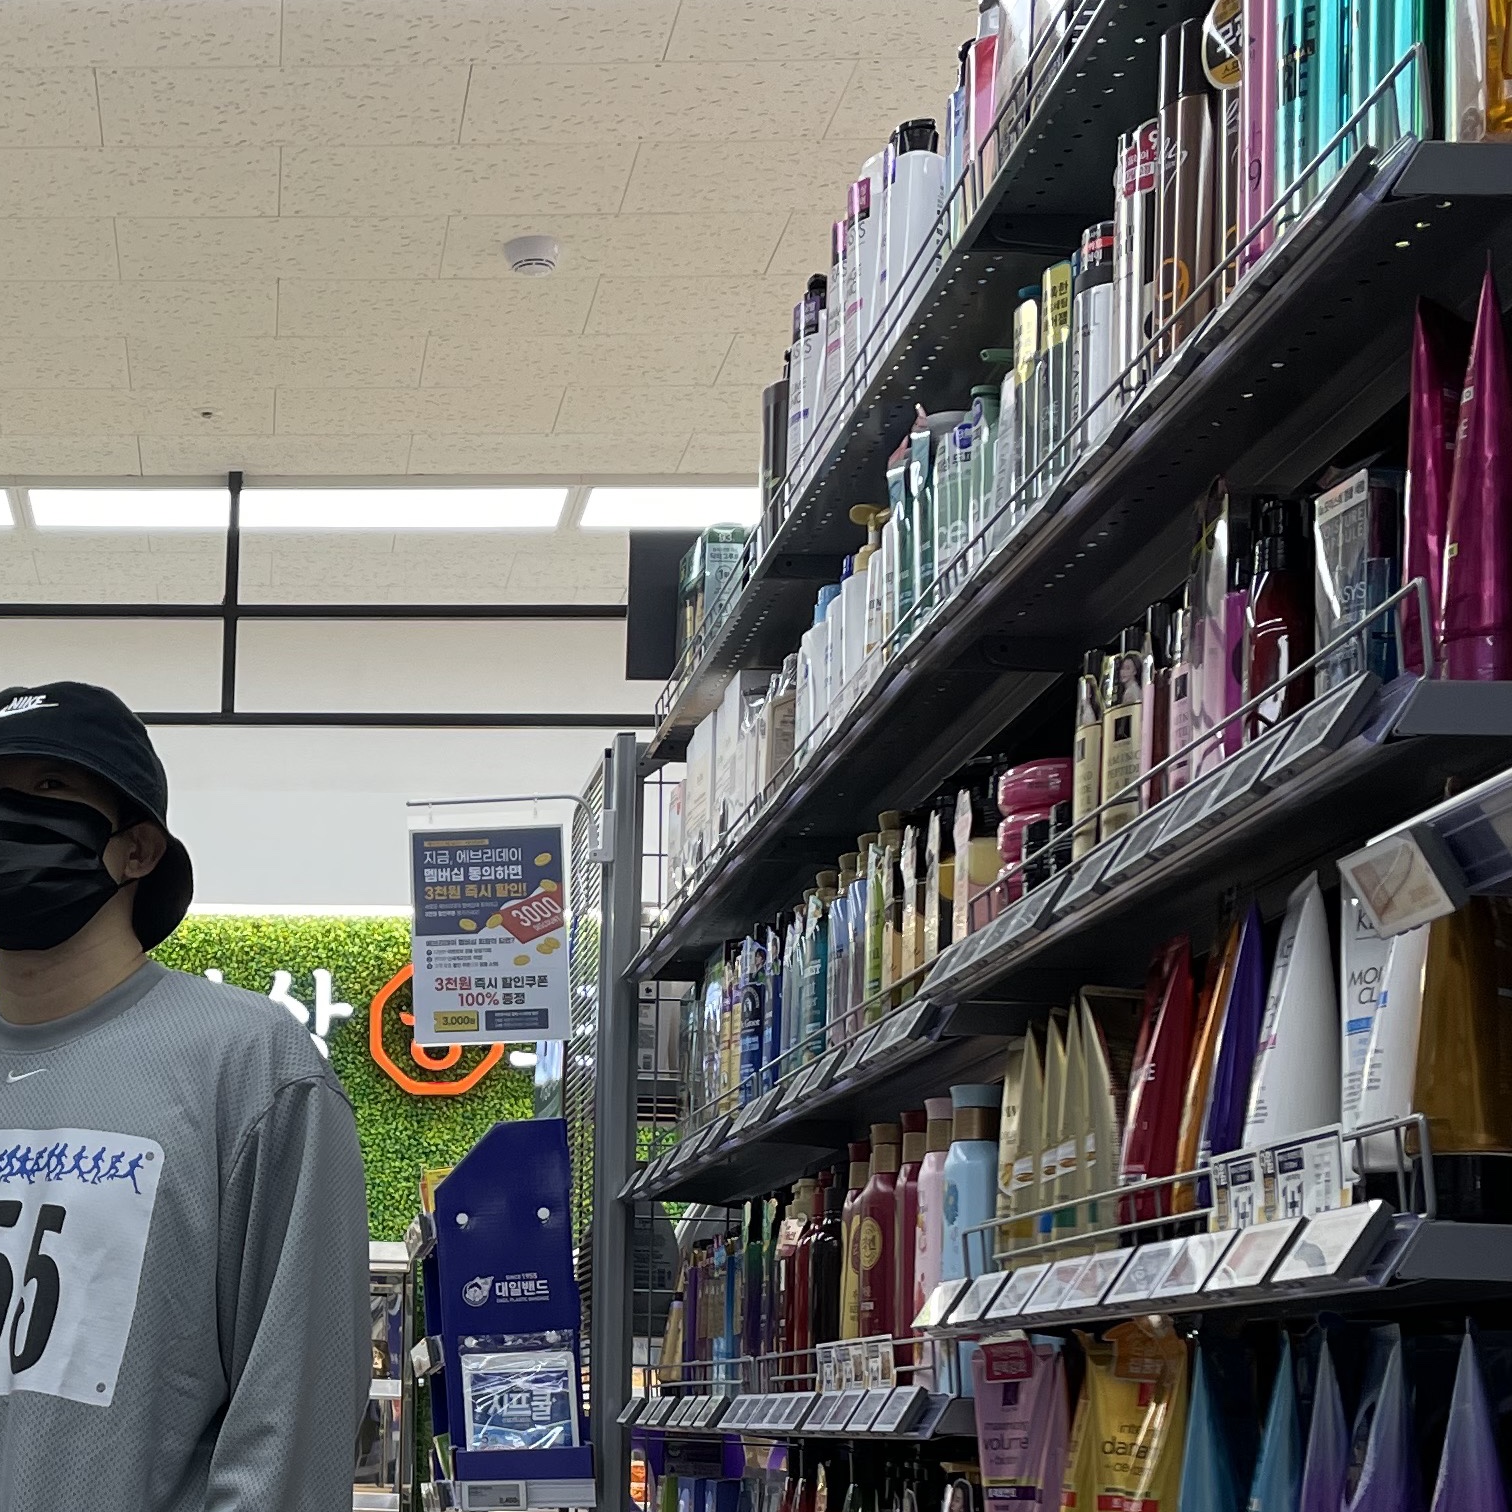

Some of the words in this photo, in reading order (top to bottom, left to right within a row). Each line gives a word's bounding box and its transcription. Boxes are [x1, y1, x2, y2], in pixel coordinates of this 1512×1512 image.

[7, 695, 46, 711] NIKE
[424, 850, 453, 865] 지금,
[456, 848, 522, 863] 에브리데이
[424, 867, 464, 882] 멤버십
[468, 865, 523, 881] 동의하면
[424, 884, 461, 900] 3천원
[465, 883, 492, 898] 즉시
[496, 883, 527, 898] 할인!
[511, 896, 562, 927] 3000
[435, 976, 471, 991] 3천원
[474, 976, 497, 989] 즉시
[501, 975, 549, 989] 할인쿠폰
[458, 992, 499, 1007] 100%
[502, 992, 526, 1005] 증정
[495, 1280, 550, 1297] 대일밴드
